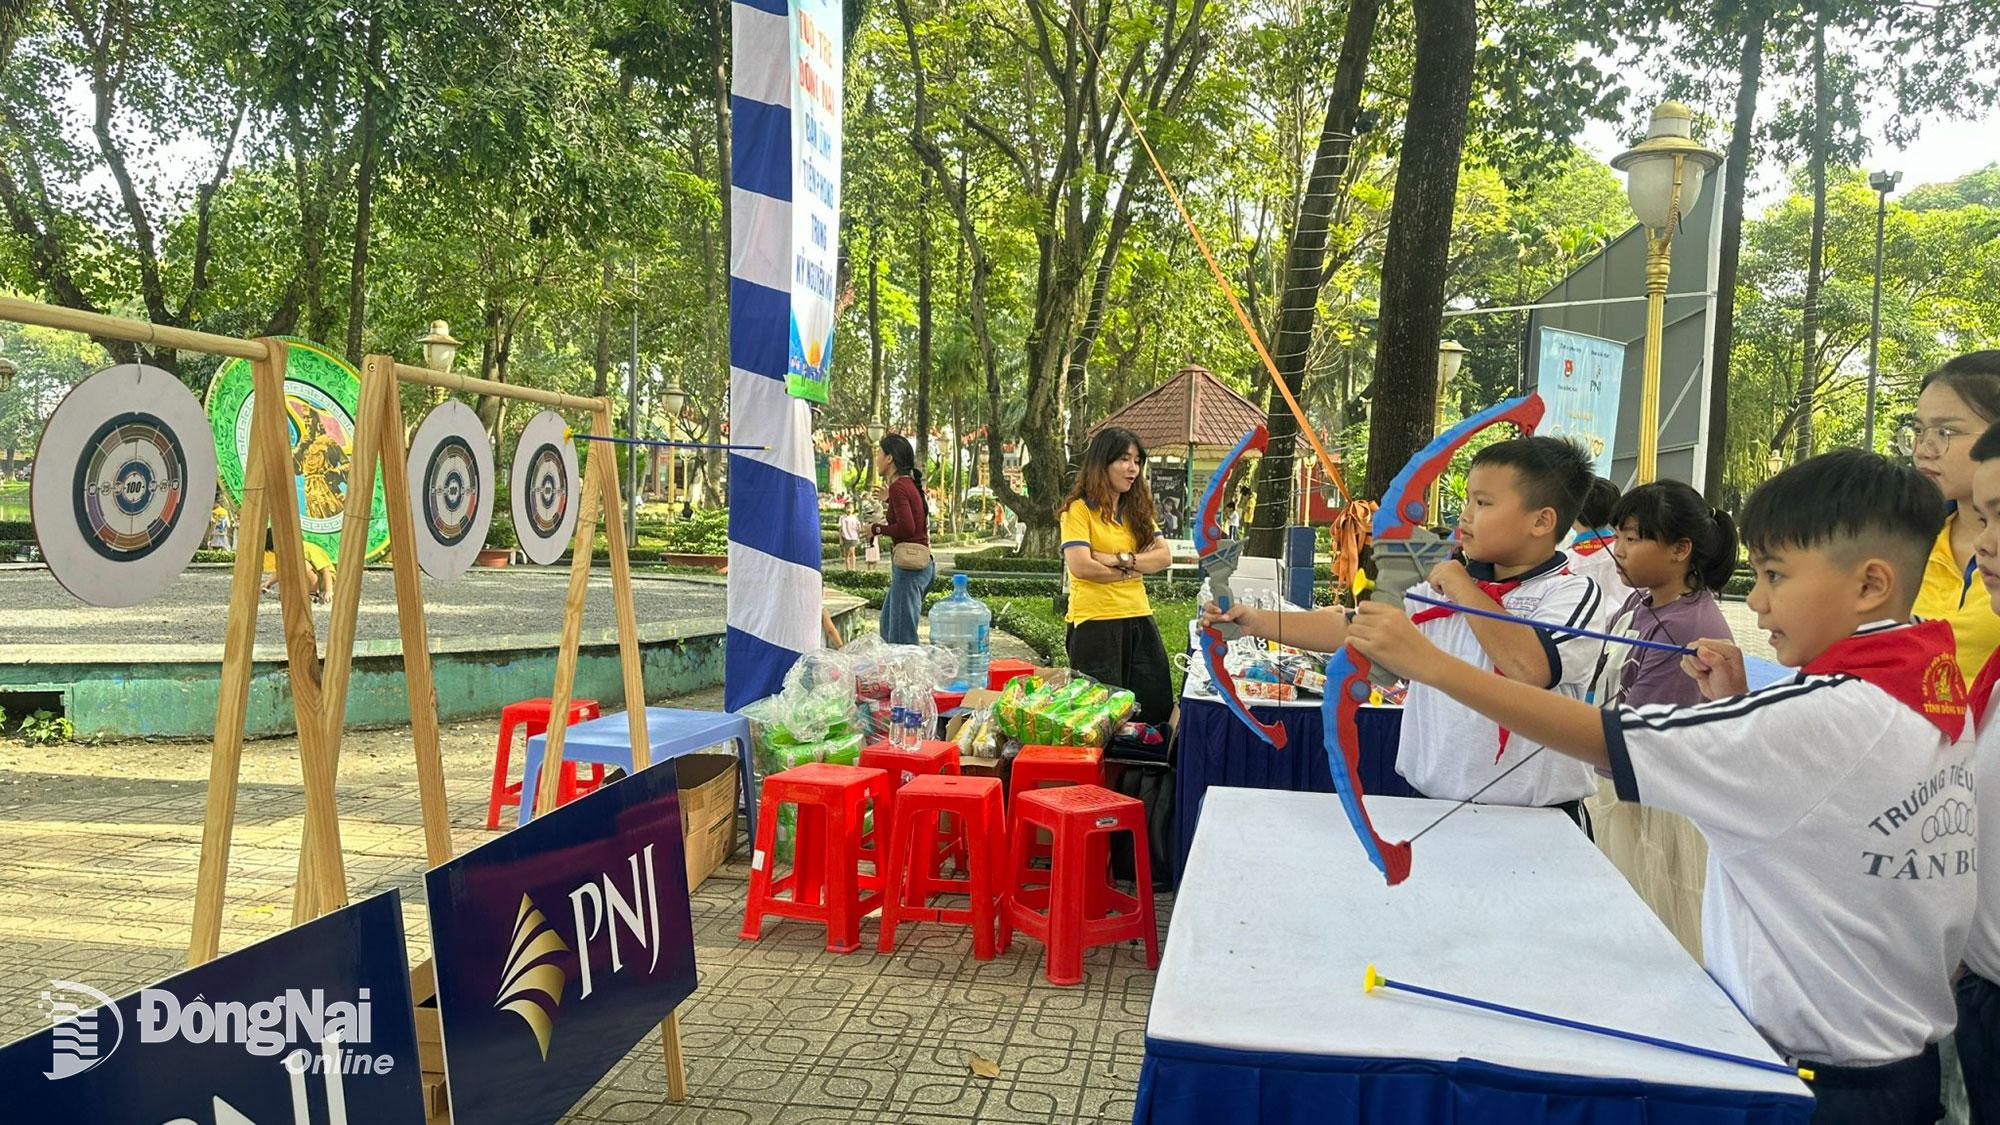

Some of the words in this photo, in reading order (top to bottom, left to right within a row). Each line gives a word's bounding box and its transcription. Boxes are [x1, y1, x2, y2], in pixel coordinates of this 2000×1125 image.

[126, 481, 142, 494] 100
[1868, 769, 1946, 837] TRƯỜNG
[1862, 848, 1948, 881] TÂN
[568, 843, 660, 1000] PNJ
